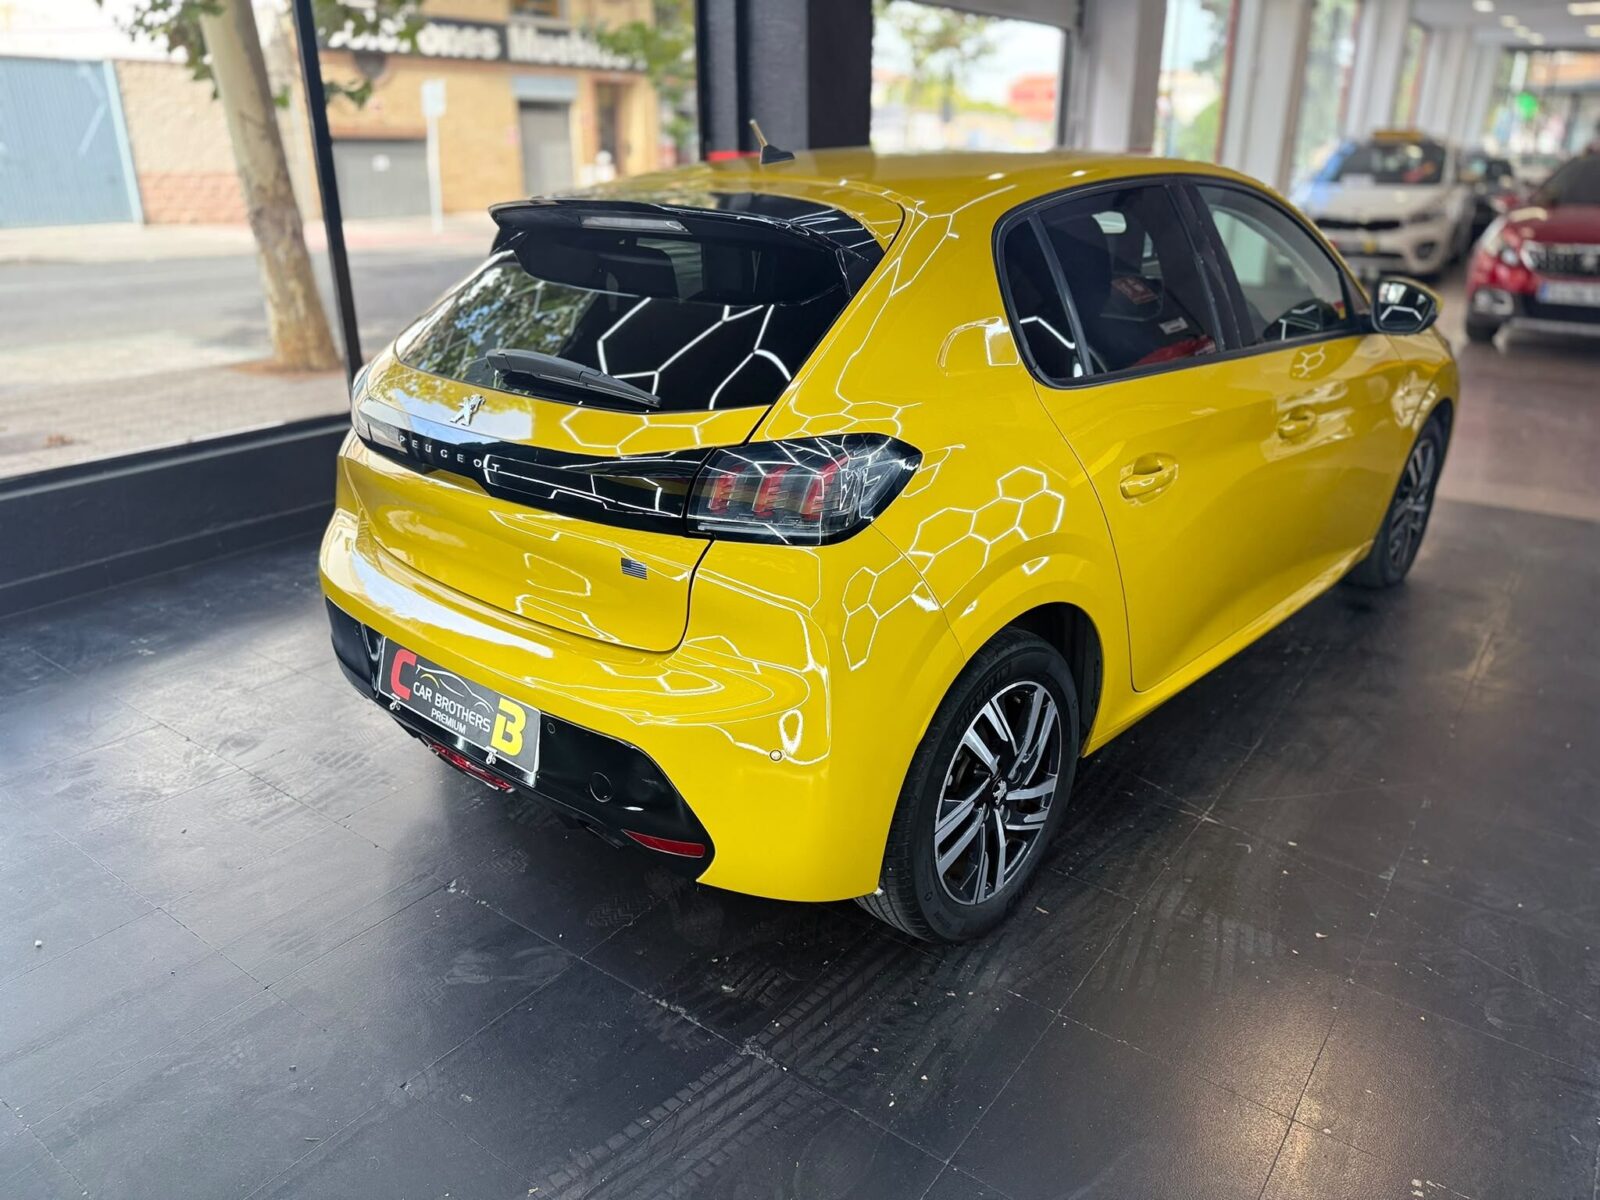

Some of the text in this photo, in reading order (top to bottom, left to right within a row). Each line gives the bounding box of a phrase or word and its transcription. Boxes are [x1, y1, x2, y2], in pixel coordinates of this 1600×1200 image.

[399, 435, 500, 472] PEUGEOT
[391, 648, 417, 701] C
[413, 682, 491, 732] CAR BROTHERS
[431, 709, 467, 735] PREMIUM
[491, 697, 527, 756] B
